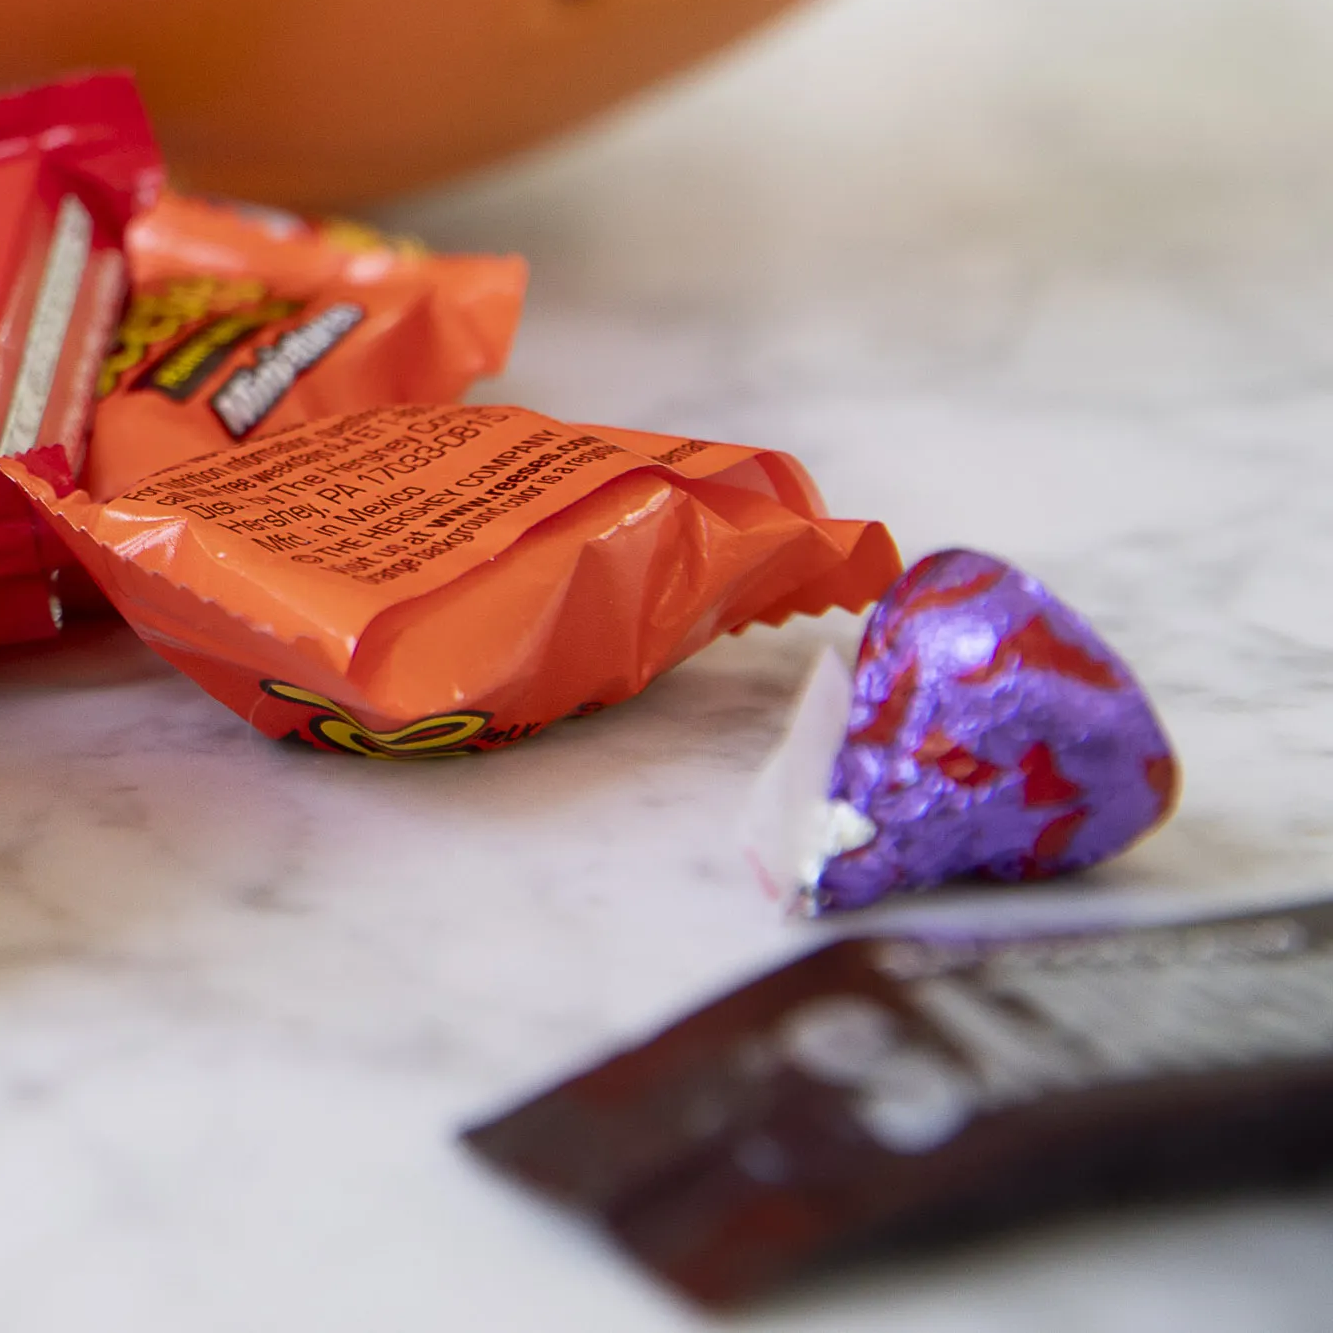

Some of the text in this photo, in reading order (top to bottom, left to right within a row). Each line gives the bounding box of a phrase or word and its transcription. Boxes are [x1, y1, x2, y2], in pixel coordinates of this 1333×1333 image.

[122, 485, 159, 502] For
[183, 500, 251, 521] Dist.
[268, 471, 327, 499] The
[321, 434, 422, 477] Hershey
[218, 501, 331, 535] Hershey,
[316, 481, 367, 506] PA
[321, 537, 373, 560] THE
[359, 488, 464, 541] HERSHEY
[455, 428, 564, 489] COMPANY
[251, 486, 426, 556] Mfd. in Mexico
[379, 543, 410, 565] us
[402, 529, 437, 547] at
[414, 505, 509, 567] background
[501, 482, 548, 515] color
[537, 471, 563, 487] is
